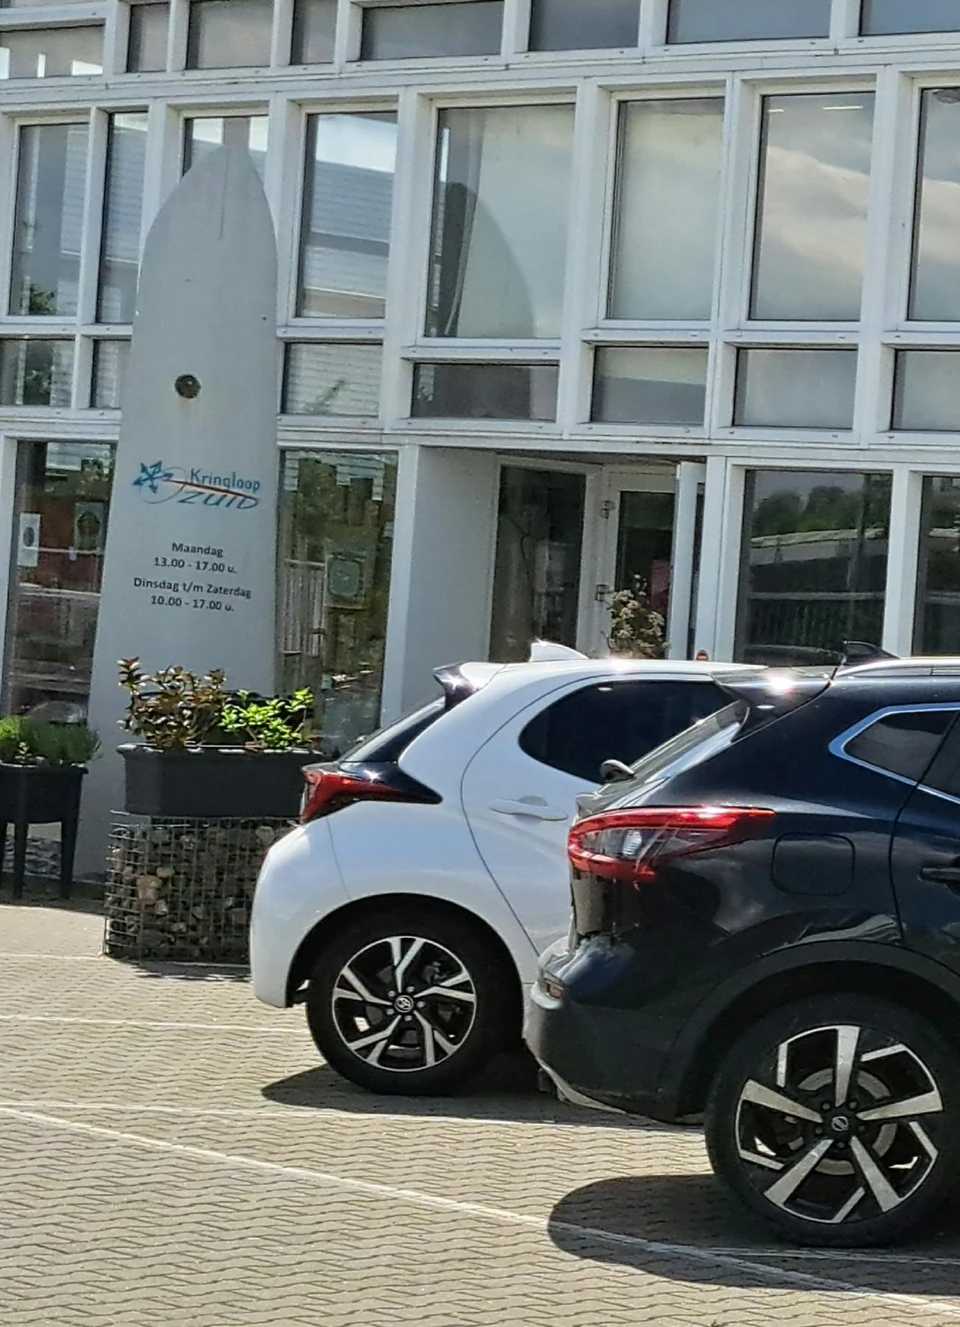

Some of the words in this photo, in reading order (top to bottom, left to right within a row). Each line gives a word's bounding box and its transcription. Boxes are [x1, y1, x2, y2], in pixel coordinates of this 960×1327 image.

[190, 468, 260, 493] Kringloop
[171, 542, 224, 558] Maandag
[154, 557, 185, 568] 13.00
[195, 560, 225, 572] 17.00
[133, 577, 179, 592] Dinsdag
[182, 581, 203, 593] t/m
[206, 583, 252, 599] Zaterdag
[151, 595, 182, 606] 10.00
[192, 599, 222, 610] 17.00
